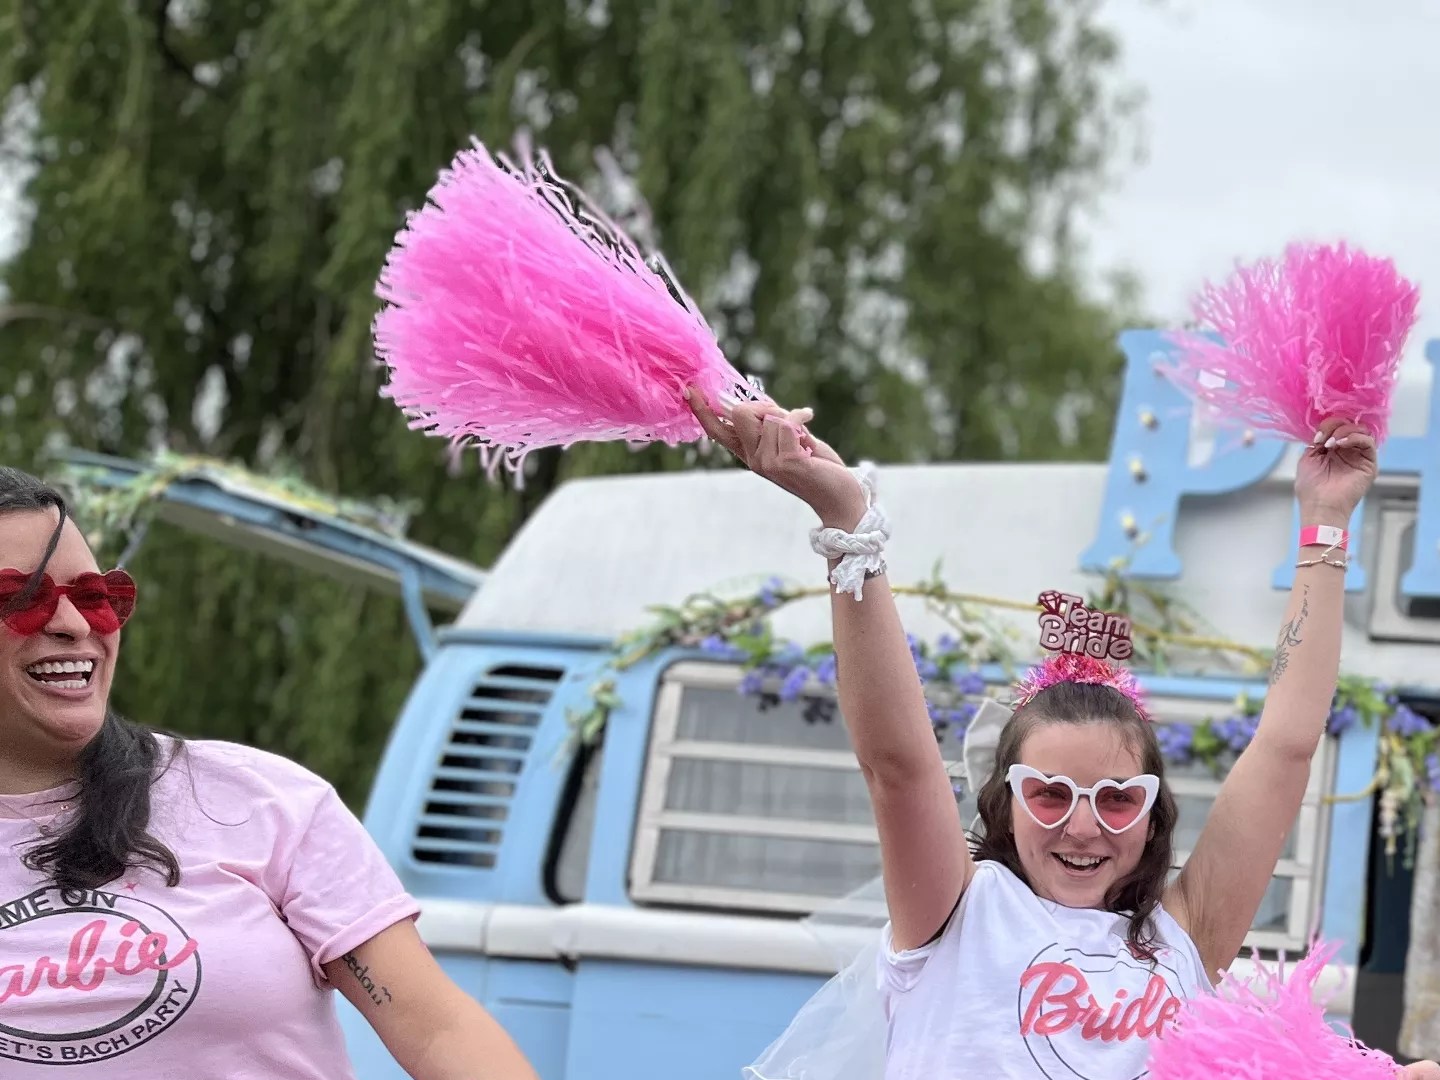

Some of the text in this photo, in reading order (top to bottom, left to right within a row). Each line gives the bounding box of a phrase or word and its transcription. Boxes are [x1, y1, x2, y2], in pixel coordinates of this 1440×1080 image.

[1038, 611, 1134, 660] Bride
[1060, 592, 1132, 638] Team
[0, 886, 121, 930] ME ON
[0, 919, 199, 1005] arbie
[0, 979, 188, 1060] ET'S BACH PARTY
